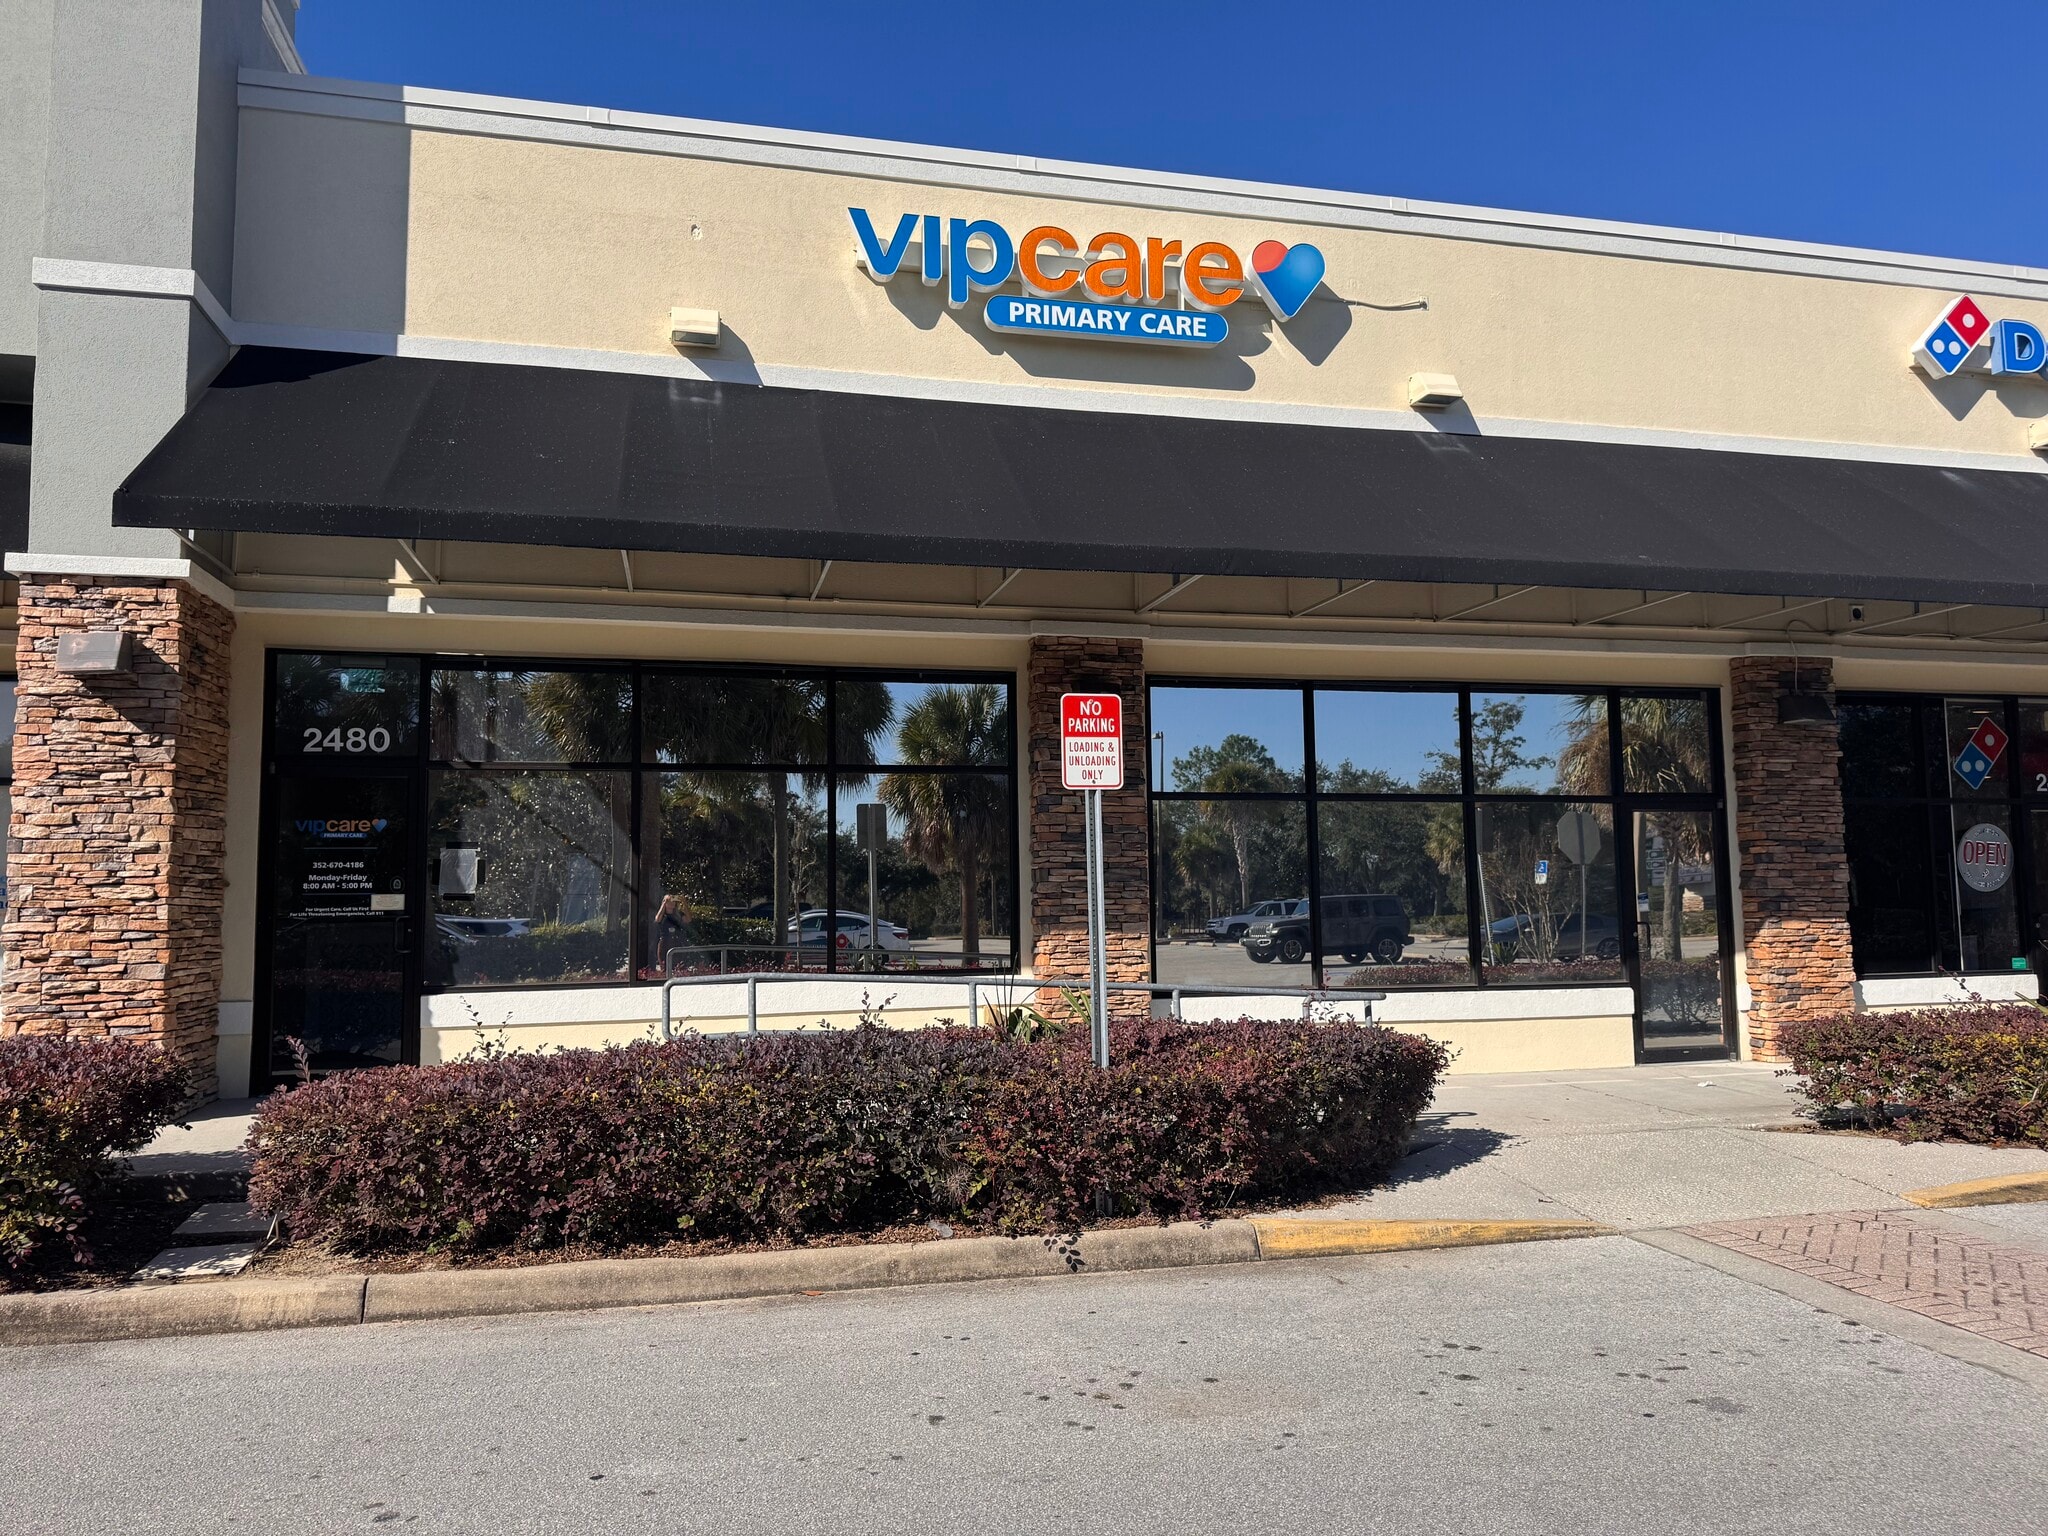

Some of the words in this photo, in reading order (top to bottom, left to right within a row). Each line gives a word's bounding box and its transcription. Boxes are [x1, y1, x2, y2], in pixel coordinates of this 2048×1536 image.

[1008, 302, 1131, 333] PRIMARY
[1139, 312, 1208, 338] CARE
[1079, 701, 1102, 716] NO
[1068, 718, 1115, 732] PARKING
[302, 727, 391, 753] 2480
[1069, 742, 1105, 752] LOADING
[1108, 742, 1115, 752] &
[1069, 756, 1116, 766] UNLOADING
[1082, 770, 1103, 780] ONLY
[295, 819, 371, 835] vipcare
[1963, 839, 2008, 867] OPEN
[312, 861, 365, 869] 352-670-4186
[308, 873, 368, 882] Monday-Friday
[303, 882, 320, 890] 8:00
